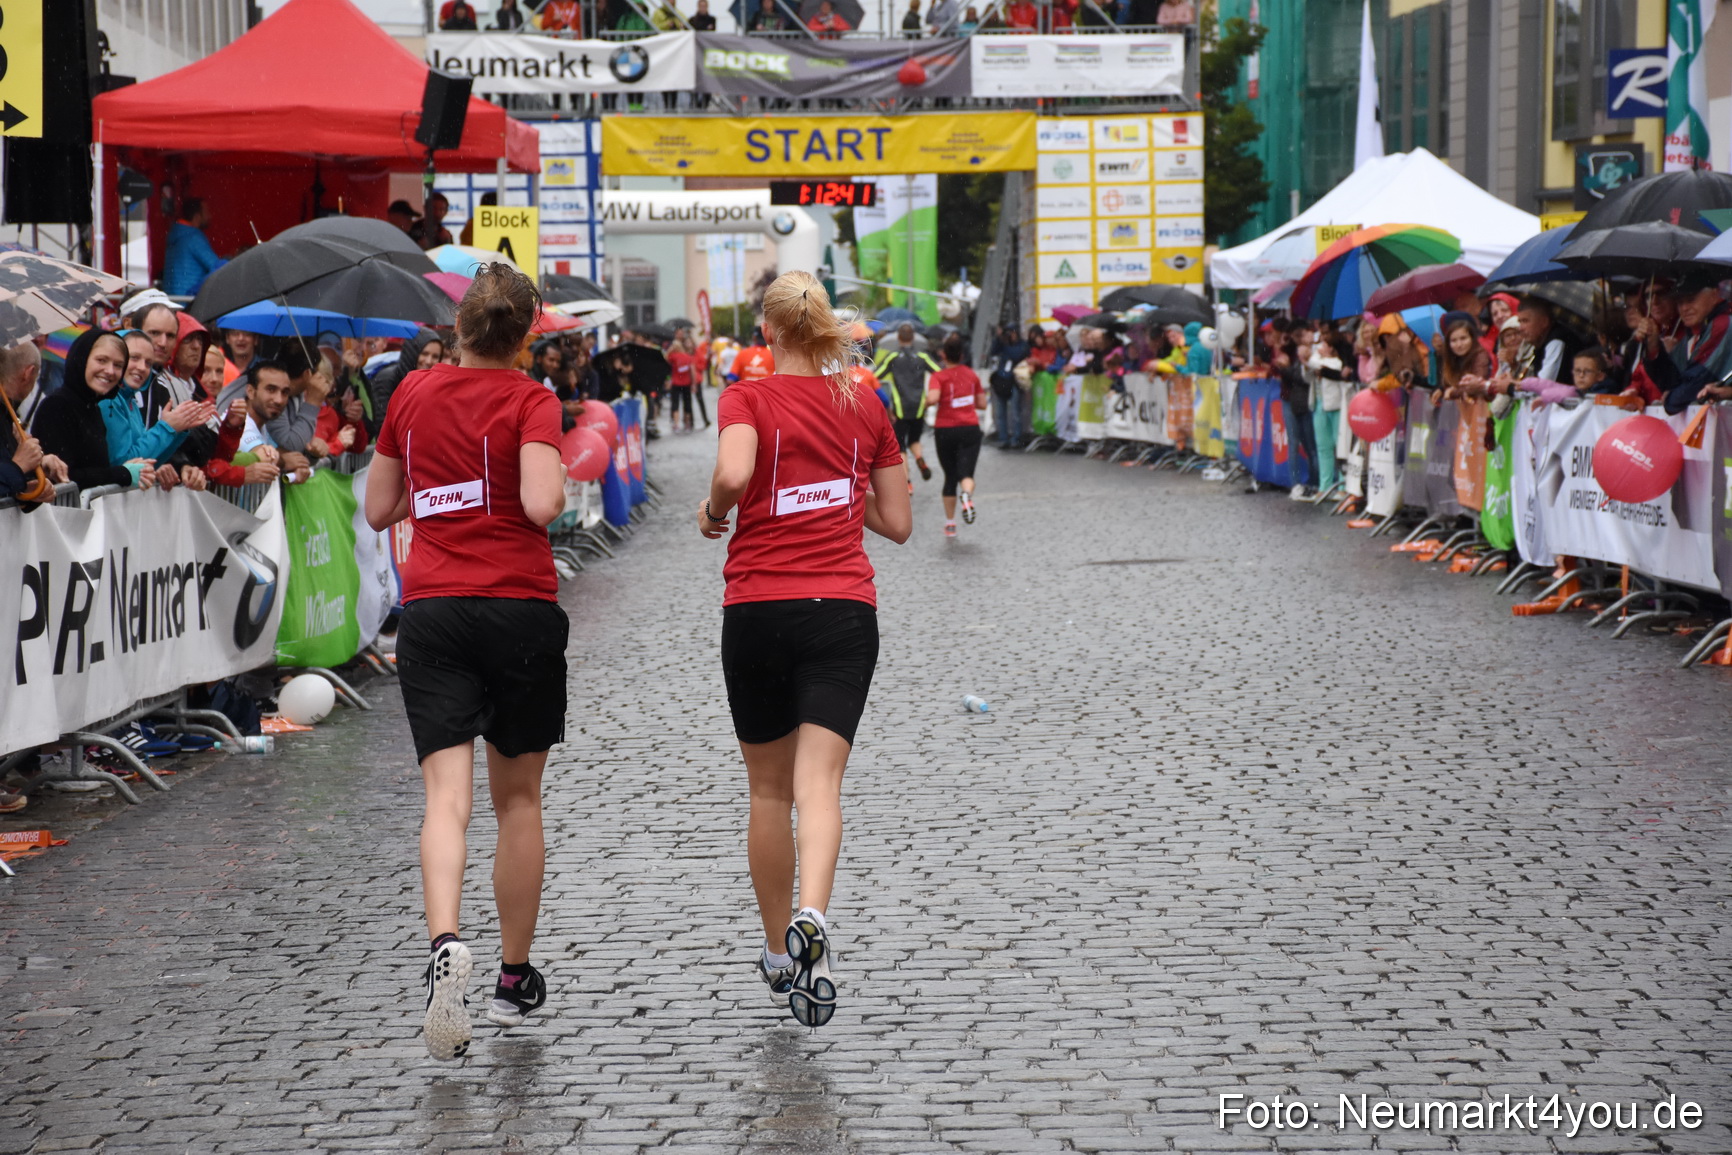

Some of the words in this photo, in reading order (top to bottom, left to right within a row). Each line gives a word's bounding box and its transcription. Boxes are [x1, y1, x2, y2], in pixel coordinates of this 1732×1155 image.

[704, 50, 790, 73] BOCK
[746, 128, 892, 163] START
[481, 211, 529, 228] Block
[649, 202, 762, 224] Laufsport
[1321, 227, 1355, 241] Blo
[429, 491, 463, 508] DEHN
[797, 489, 831, 504] DEHN
